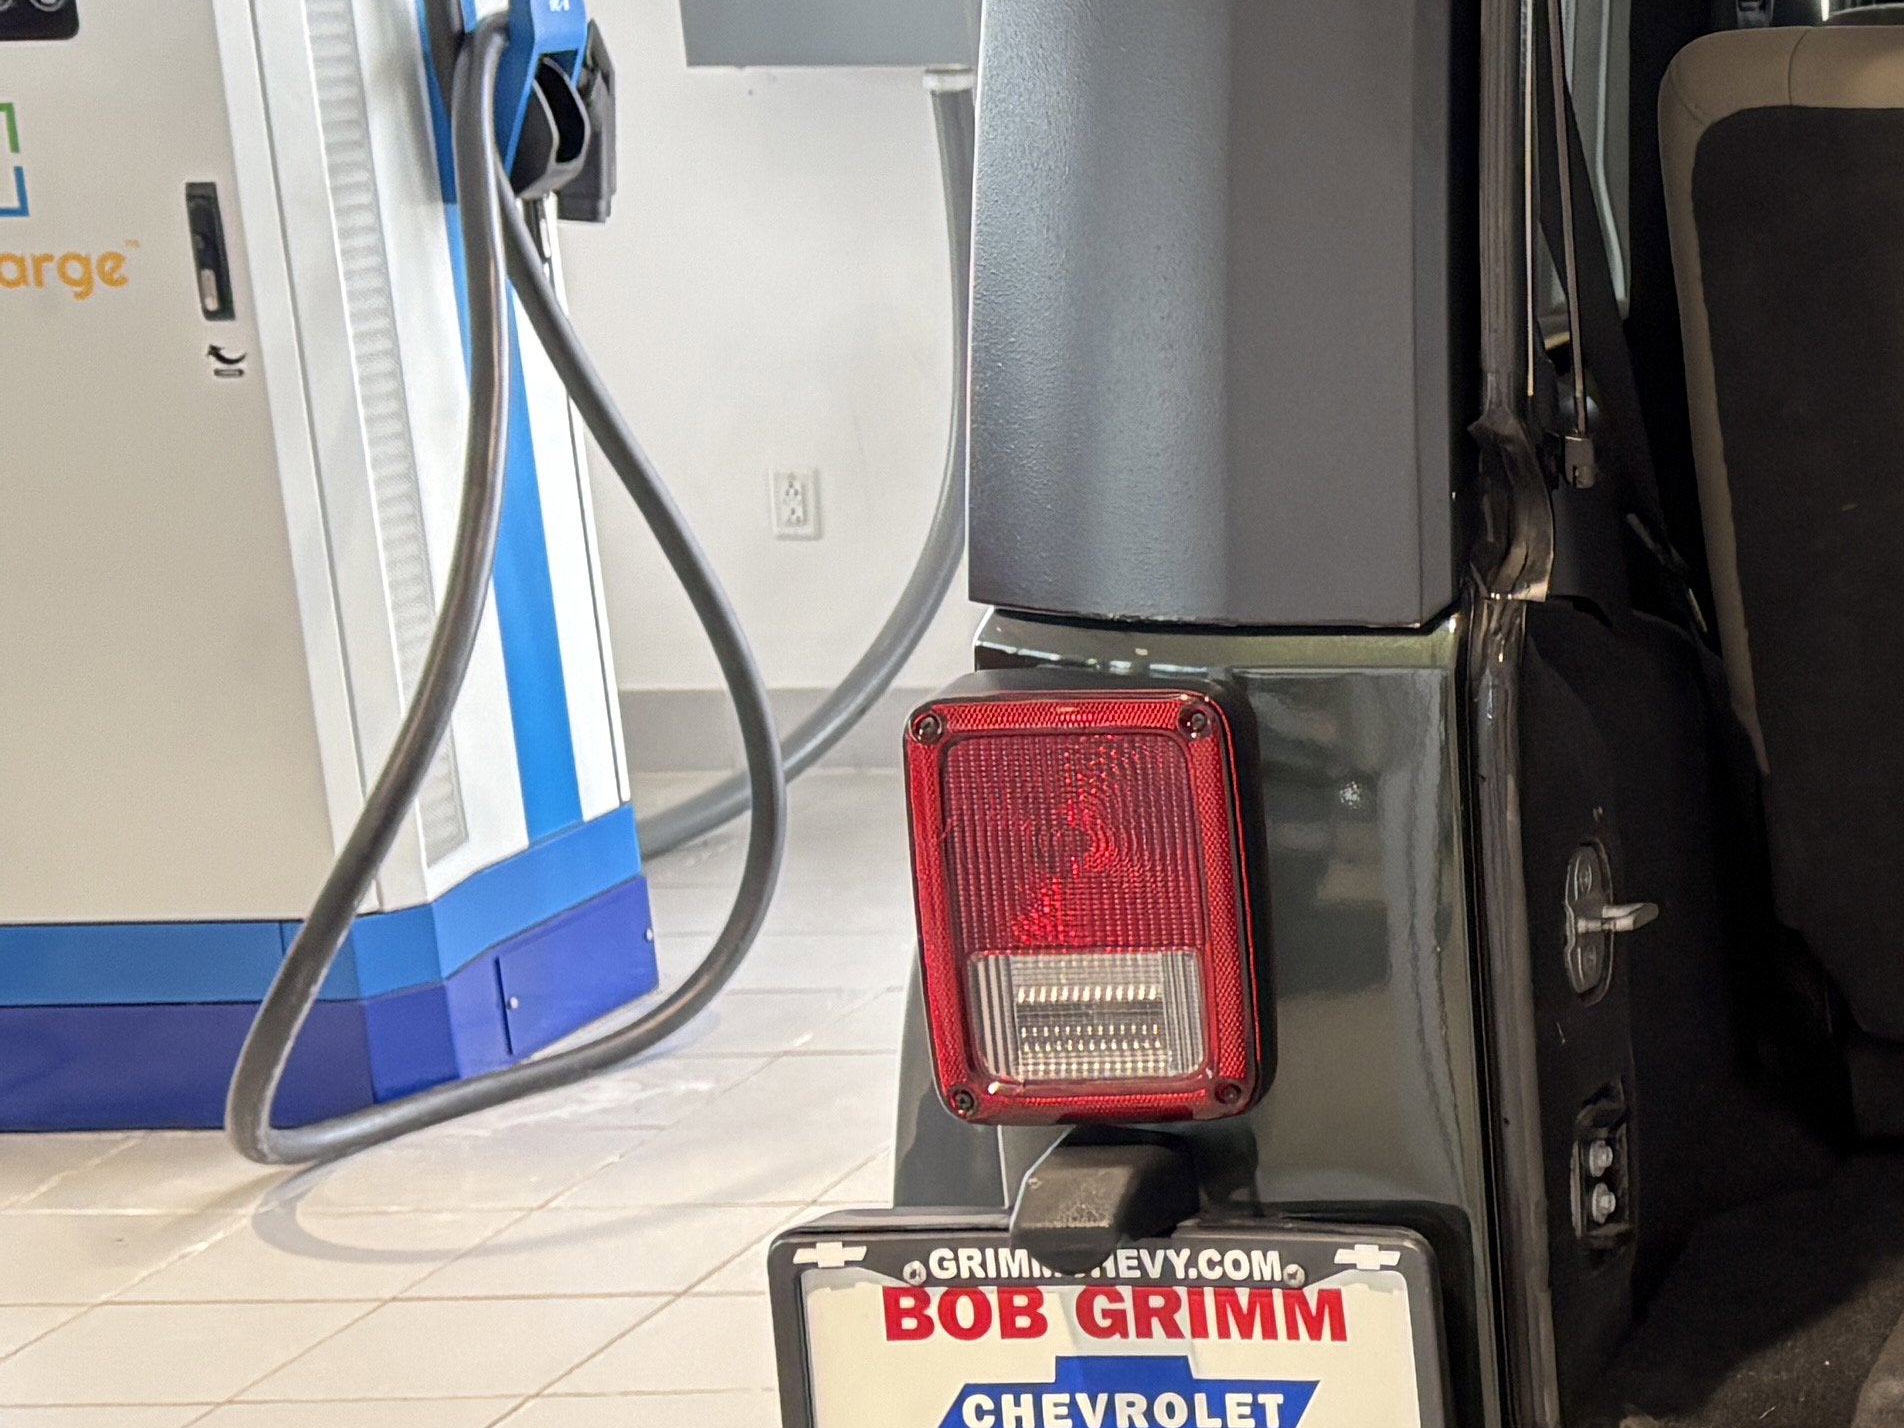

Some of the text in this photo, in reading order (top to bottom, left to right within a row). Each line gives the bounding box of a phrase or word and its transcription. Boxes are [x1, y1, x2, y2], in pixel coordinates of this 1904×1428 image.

[928, 1246, 1284, 1283] GRIMHEVY.COM
[883, 1285, 1348, 1342] BOB GRIMM
